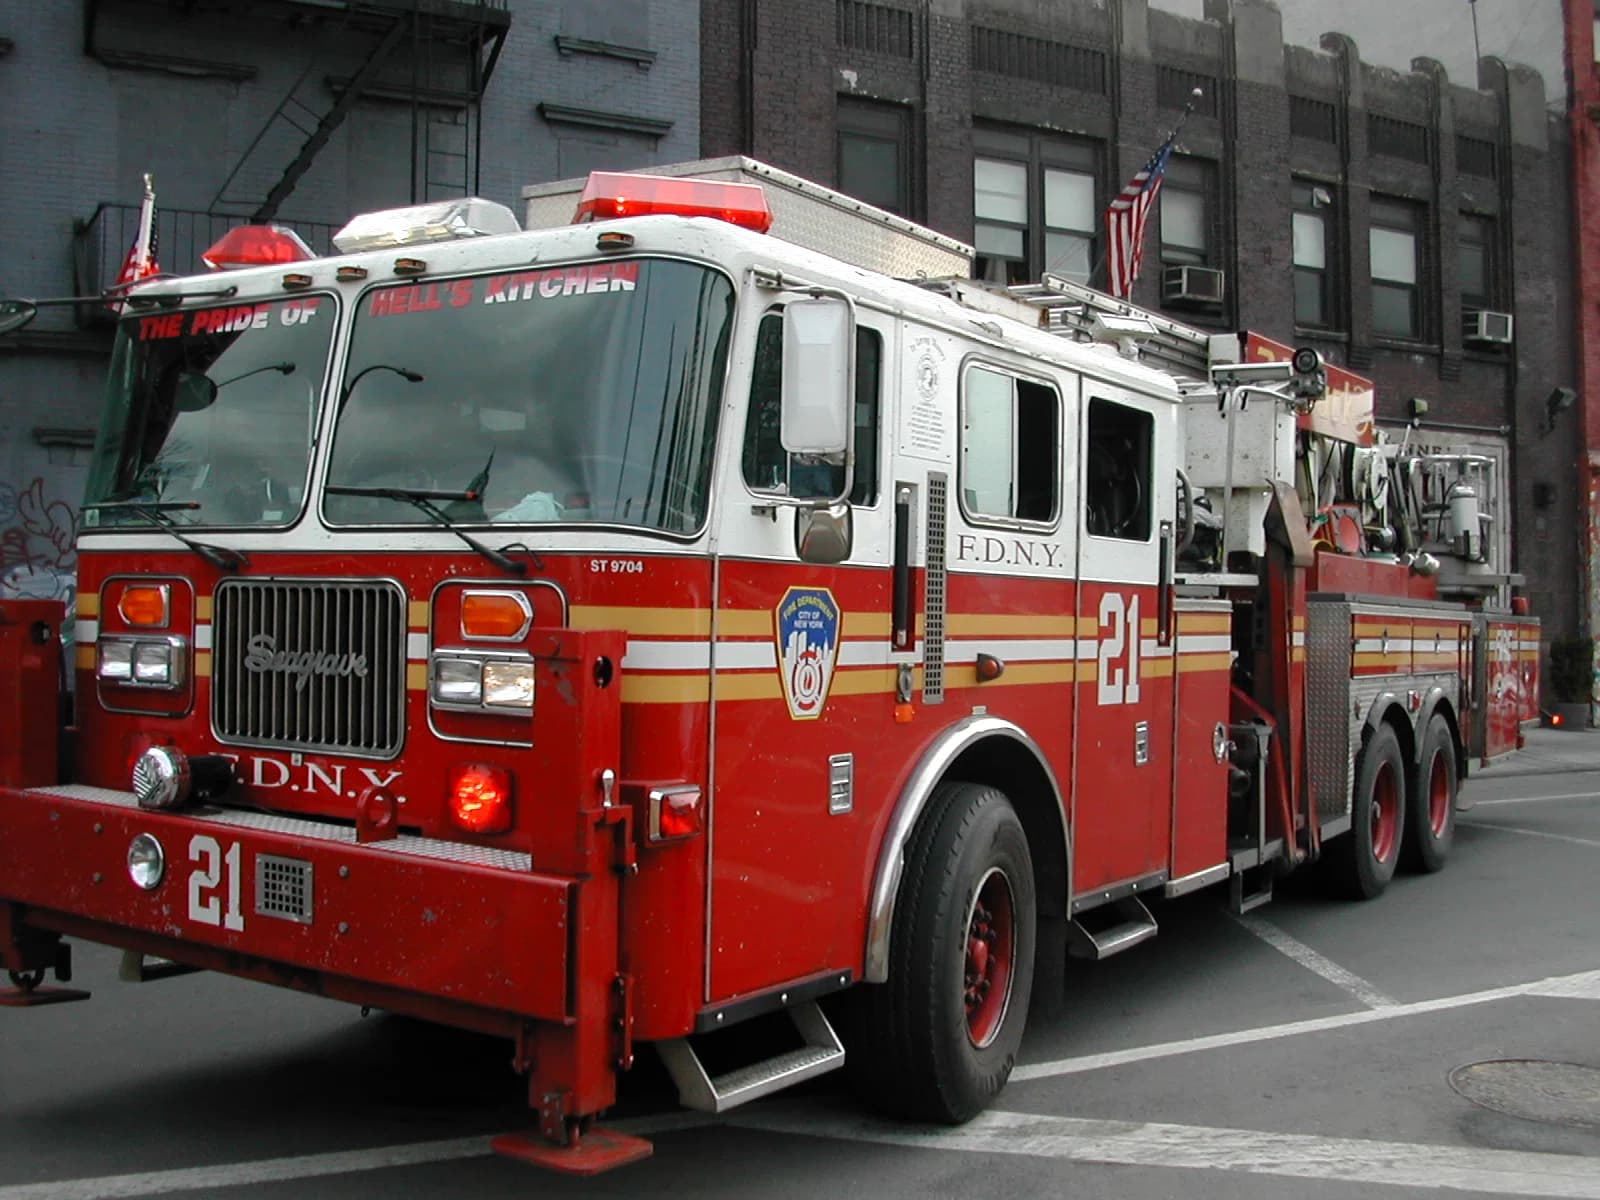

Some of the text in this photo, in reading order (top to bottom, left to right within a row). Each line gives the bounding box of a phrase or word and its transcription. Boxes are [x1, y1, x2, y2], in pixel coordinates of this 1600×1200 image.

[369, 262, 640, 318] HELL'S KITCHEN
[139, 297, 321, 340] THE PRIDE OF
[590, 559, 643, 573] ST 9704
[956, 534, 1063, 567] F.D.N.Y.
[798, 611, 820, 619] CITY OF
[244, 634, 368, 692] Seagrave
[1097, 591, 1139, 705] 21
[188, 834, 245, 932] 21
